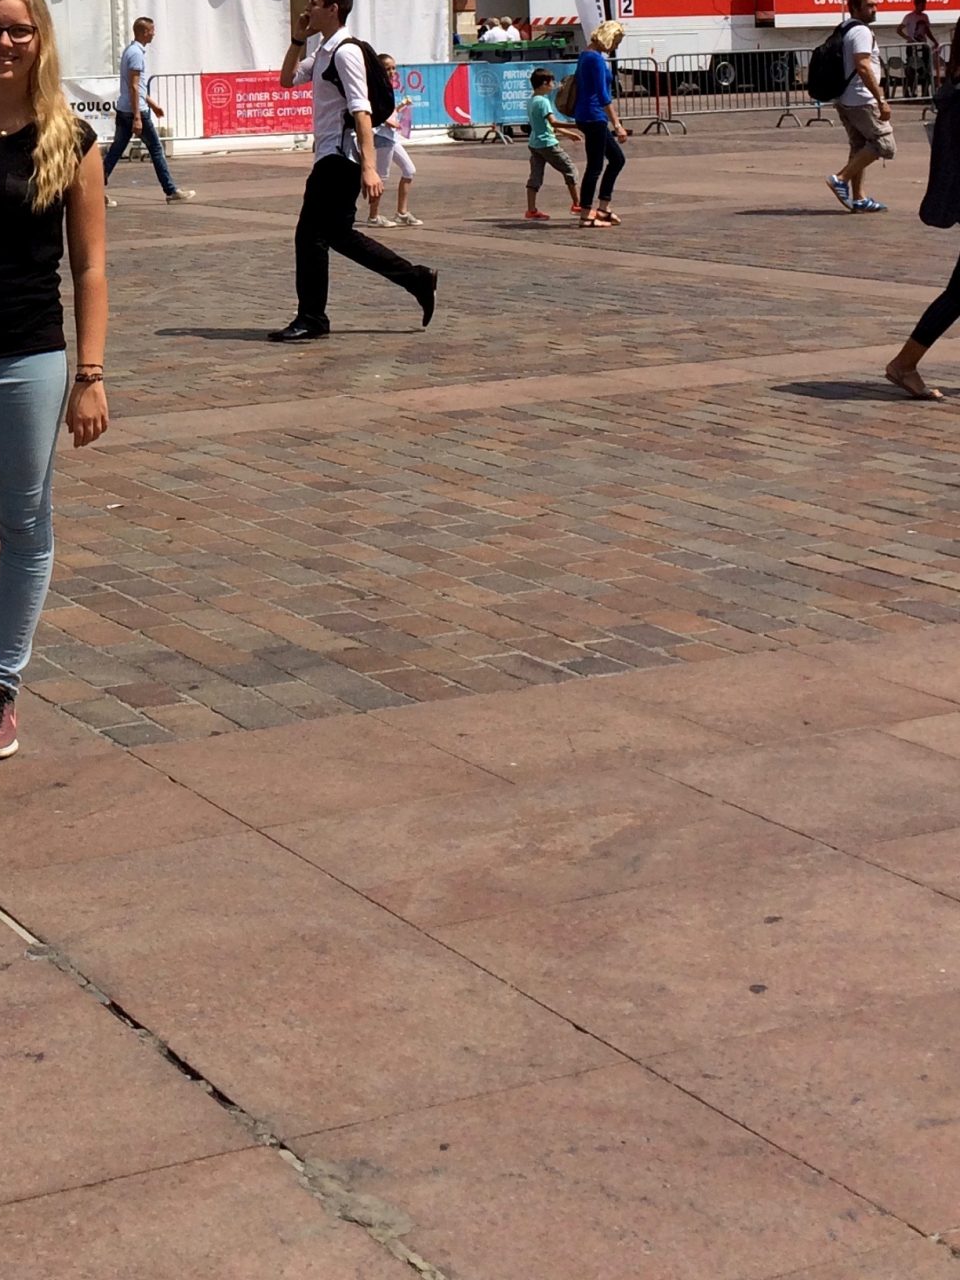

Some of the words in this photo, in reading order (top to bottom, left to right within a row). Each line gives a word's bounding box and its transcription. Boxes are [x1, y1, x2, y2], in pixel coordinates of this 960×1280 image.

[502, 80, 527, 90] VOTRE
[236, 92, 270, 102] DONNER
[272, 91, 290, 101] SON
[502, 90, 534, 100] DONNEZ
[501, 101, 527, 110] VOTRE
[236, 108, 274, 118] PARTAGE
[277, 107, 312, 117] CITOYEN
